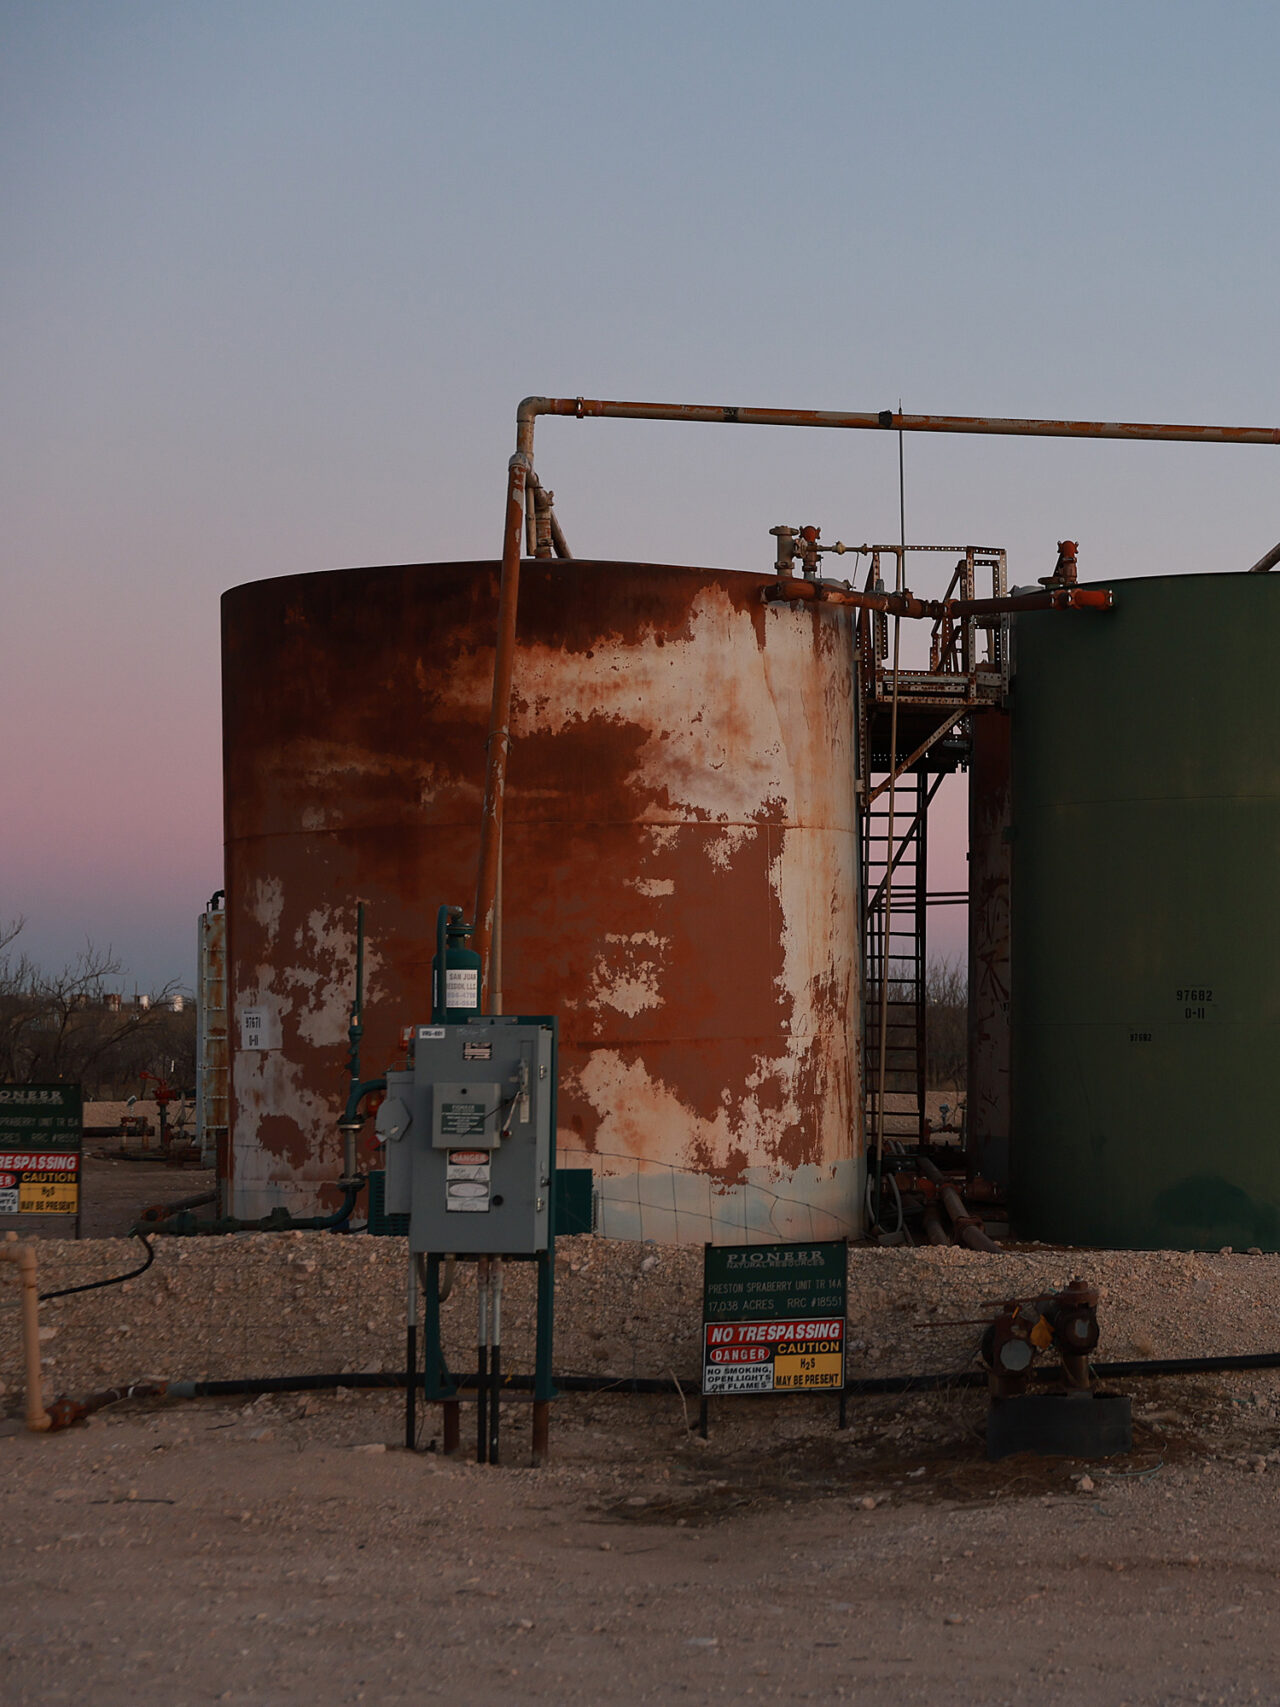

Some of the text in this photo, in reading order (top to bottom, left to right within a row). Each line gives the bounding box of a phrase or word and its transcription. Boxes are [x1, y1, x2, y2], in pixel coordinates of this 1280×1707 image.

[1176, 989, 1213, 1001] 97682
[0, 1090, 62, 1101] ONEER
[0, 1155, 77, 1170] RESPASSING
[21, 1172, 77, 1183] CAUTION
[727, 1250, 822, 1263] PIONEER
[708, 1279, 842, 1294] PRESTON SPRABERRY UNIT TR 14A
[709, 1296, 842, 1312] 17,038 ACRES RRC #18551
[711, 1322, 840, 1342] NO TRESPASSING
[777, 1341, 840, 1354] CAUTION
[715, 1349, 766, 1361] DANGER
[800, 1358, 816, 1370] H2S
[736, 1374, 771, 1382] LIGHTS
[776, 1373, 839, 1386] MAY BE PRESENT
[727, 1381, 767, 1389] FLAMES
